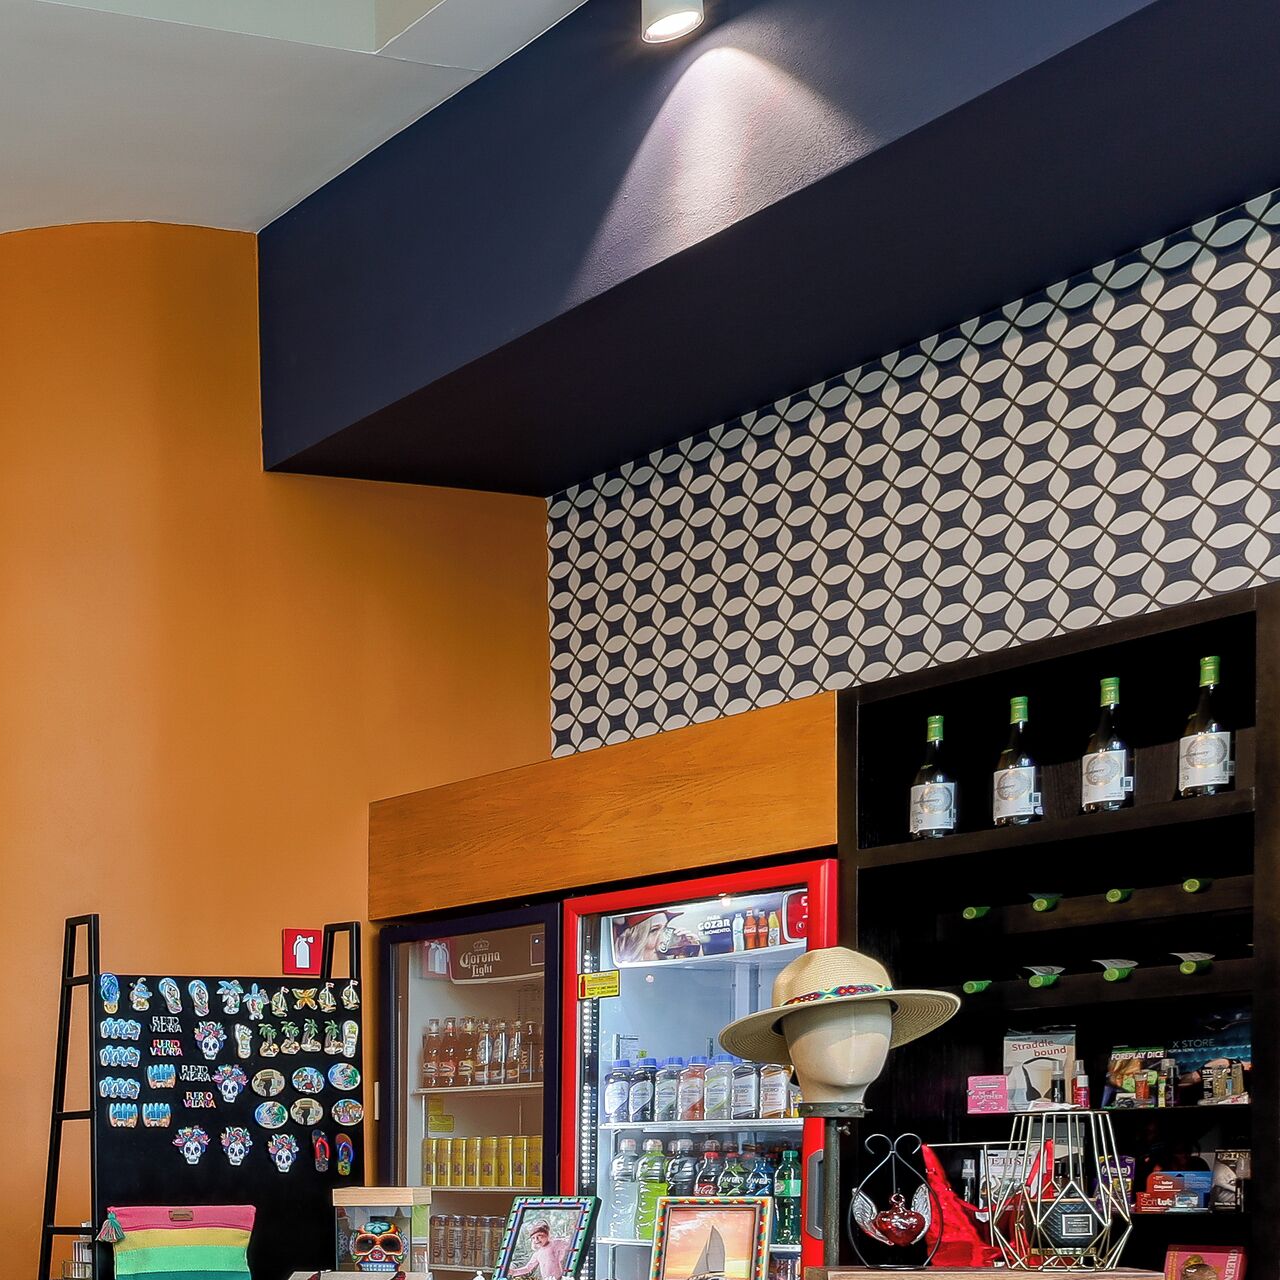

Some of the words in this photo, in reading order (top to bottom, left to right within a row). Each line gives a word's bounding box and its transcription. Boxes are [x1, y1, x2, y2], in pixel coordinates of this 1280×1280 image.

[460, 950, 501, 968] Corona
[472, 964, 493, 978] Light
[1011, 1039, 1054, 1052] Straddle
[1172, 1040, 1179, 1048] X
[1182, 1038, 1215, 1047] STORE
[1033, 1046, 1067, 1057] bound
[1111, 1051, 1145, 1060] FOREPLAY
